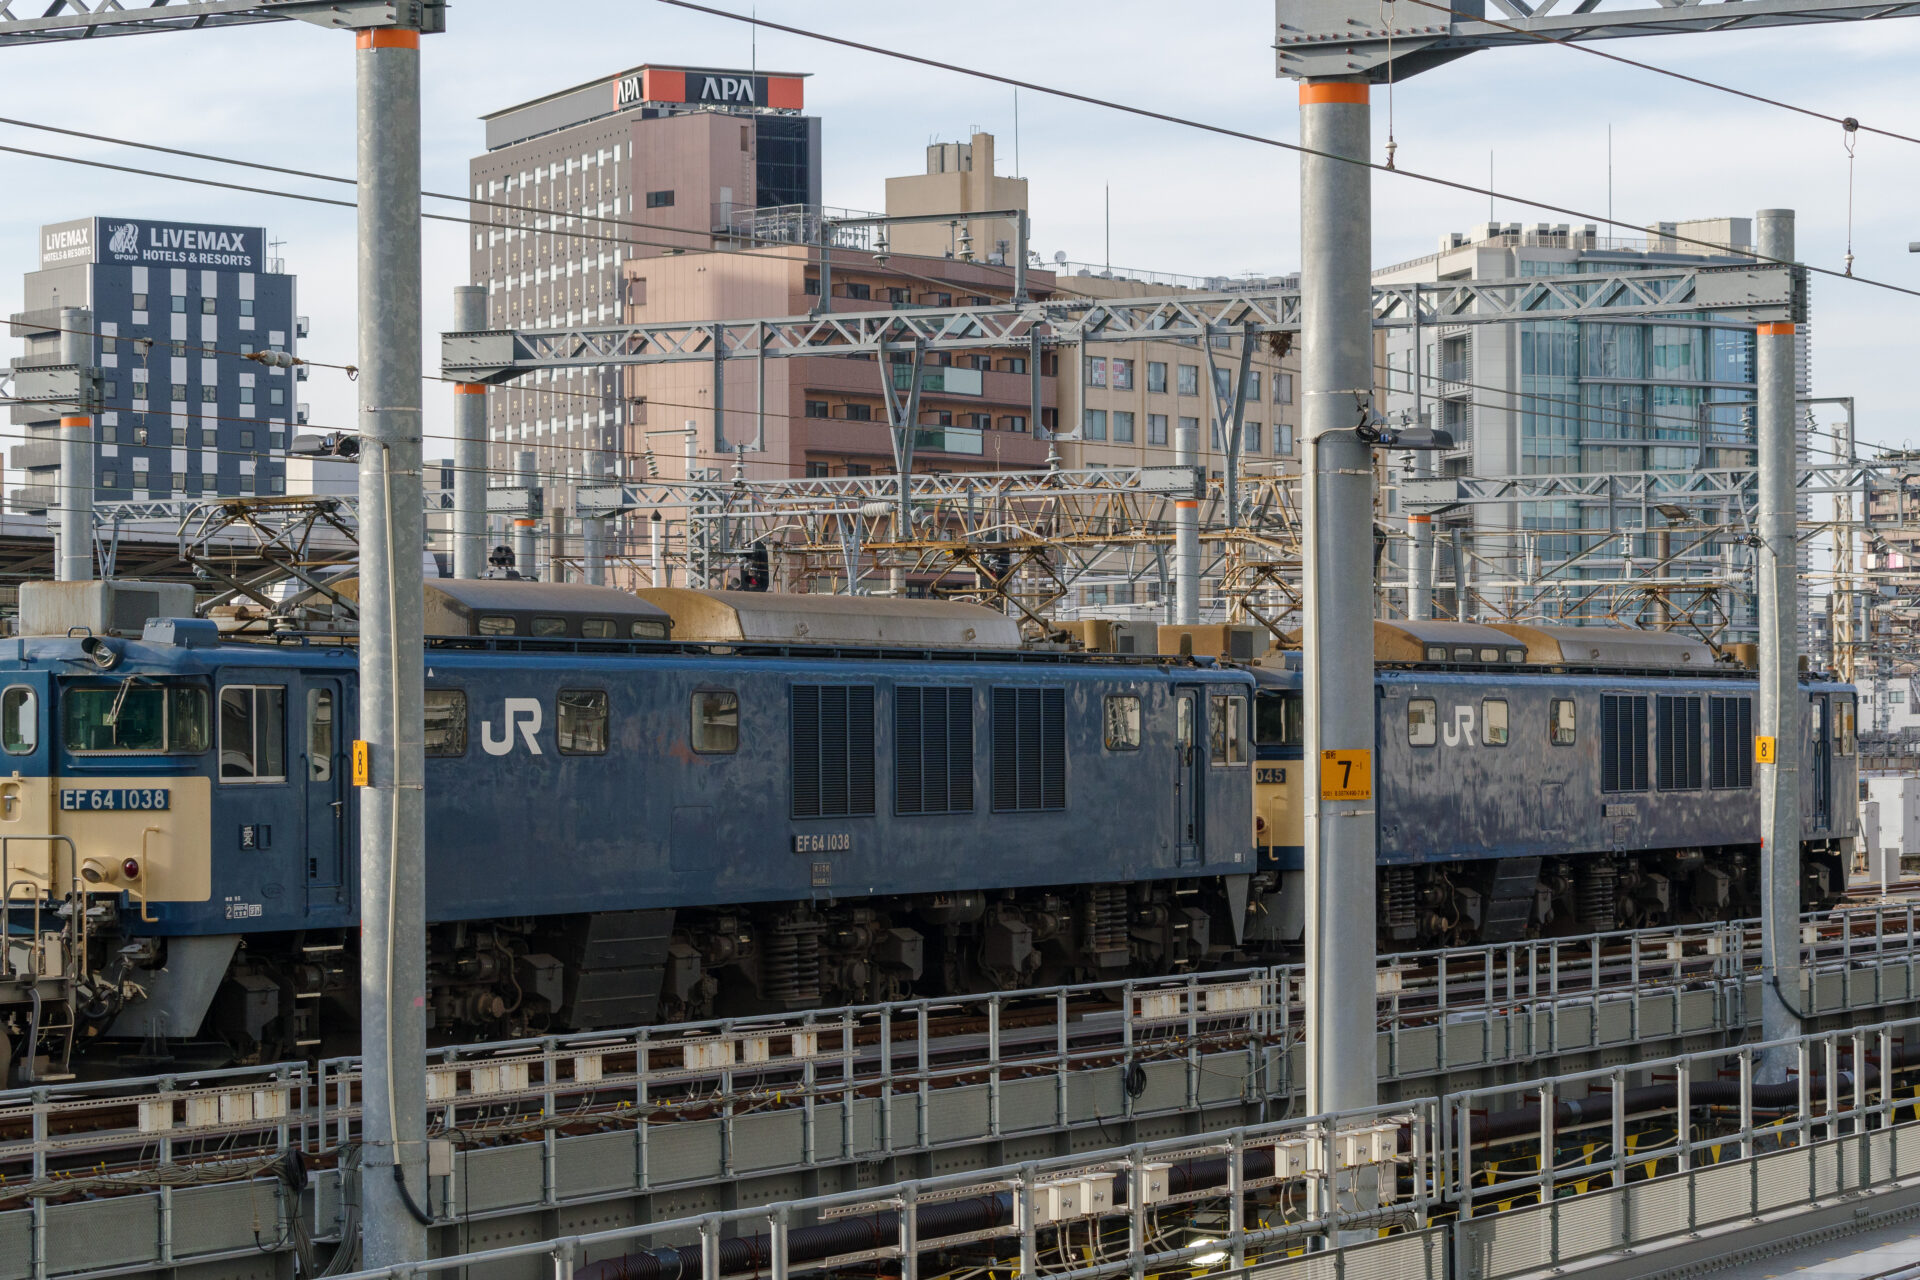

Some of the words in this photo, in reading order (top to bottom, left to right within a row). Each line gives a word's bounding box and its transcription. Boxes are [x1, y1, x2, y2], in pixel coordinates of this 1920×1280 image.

[617, 77, 640, 104] APA
[701, 77, 754, 101] APA
[43, 250, 63, 263] HOTELS
[67, 246, 91, 259] RESORTS
[142, 249, 187, 263] HOTELS
[188, 253, 198, 263] &
[199, 252, 251, 266] RESORTS
[481, 697, 543, 756] JR
[1443, 705, 1475, 747] JR
[1761, 742, 1767, 757] 8
[357, 750, 363, 776] 8
[1337, 760, 1352, 789] 7
[121, 789, 166, 809] 1038
[827, 833, 850, 850] 1038
